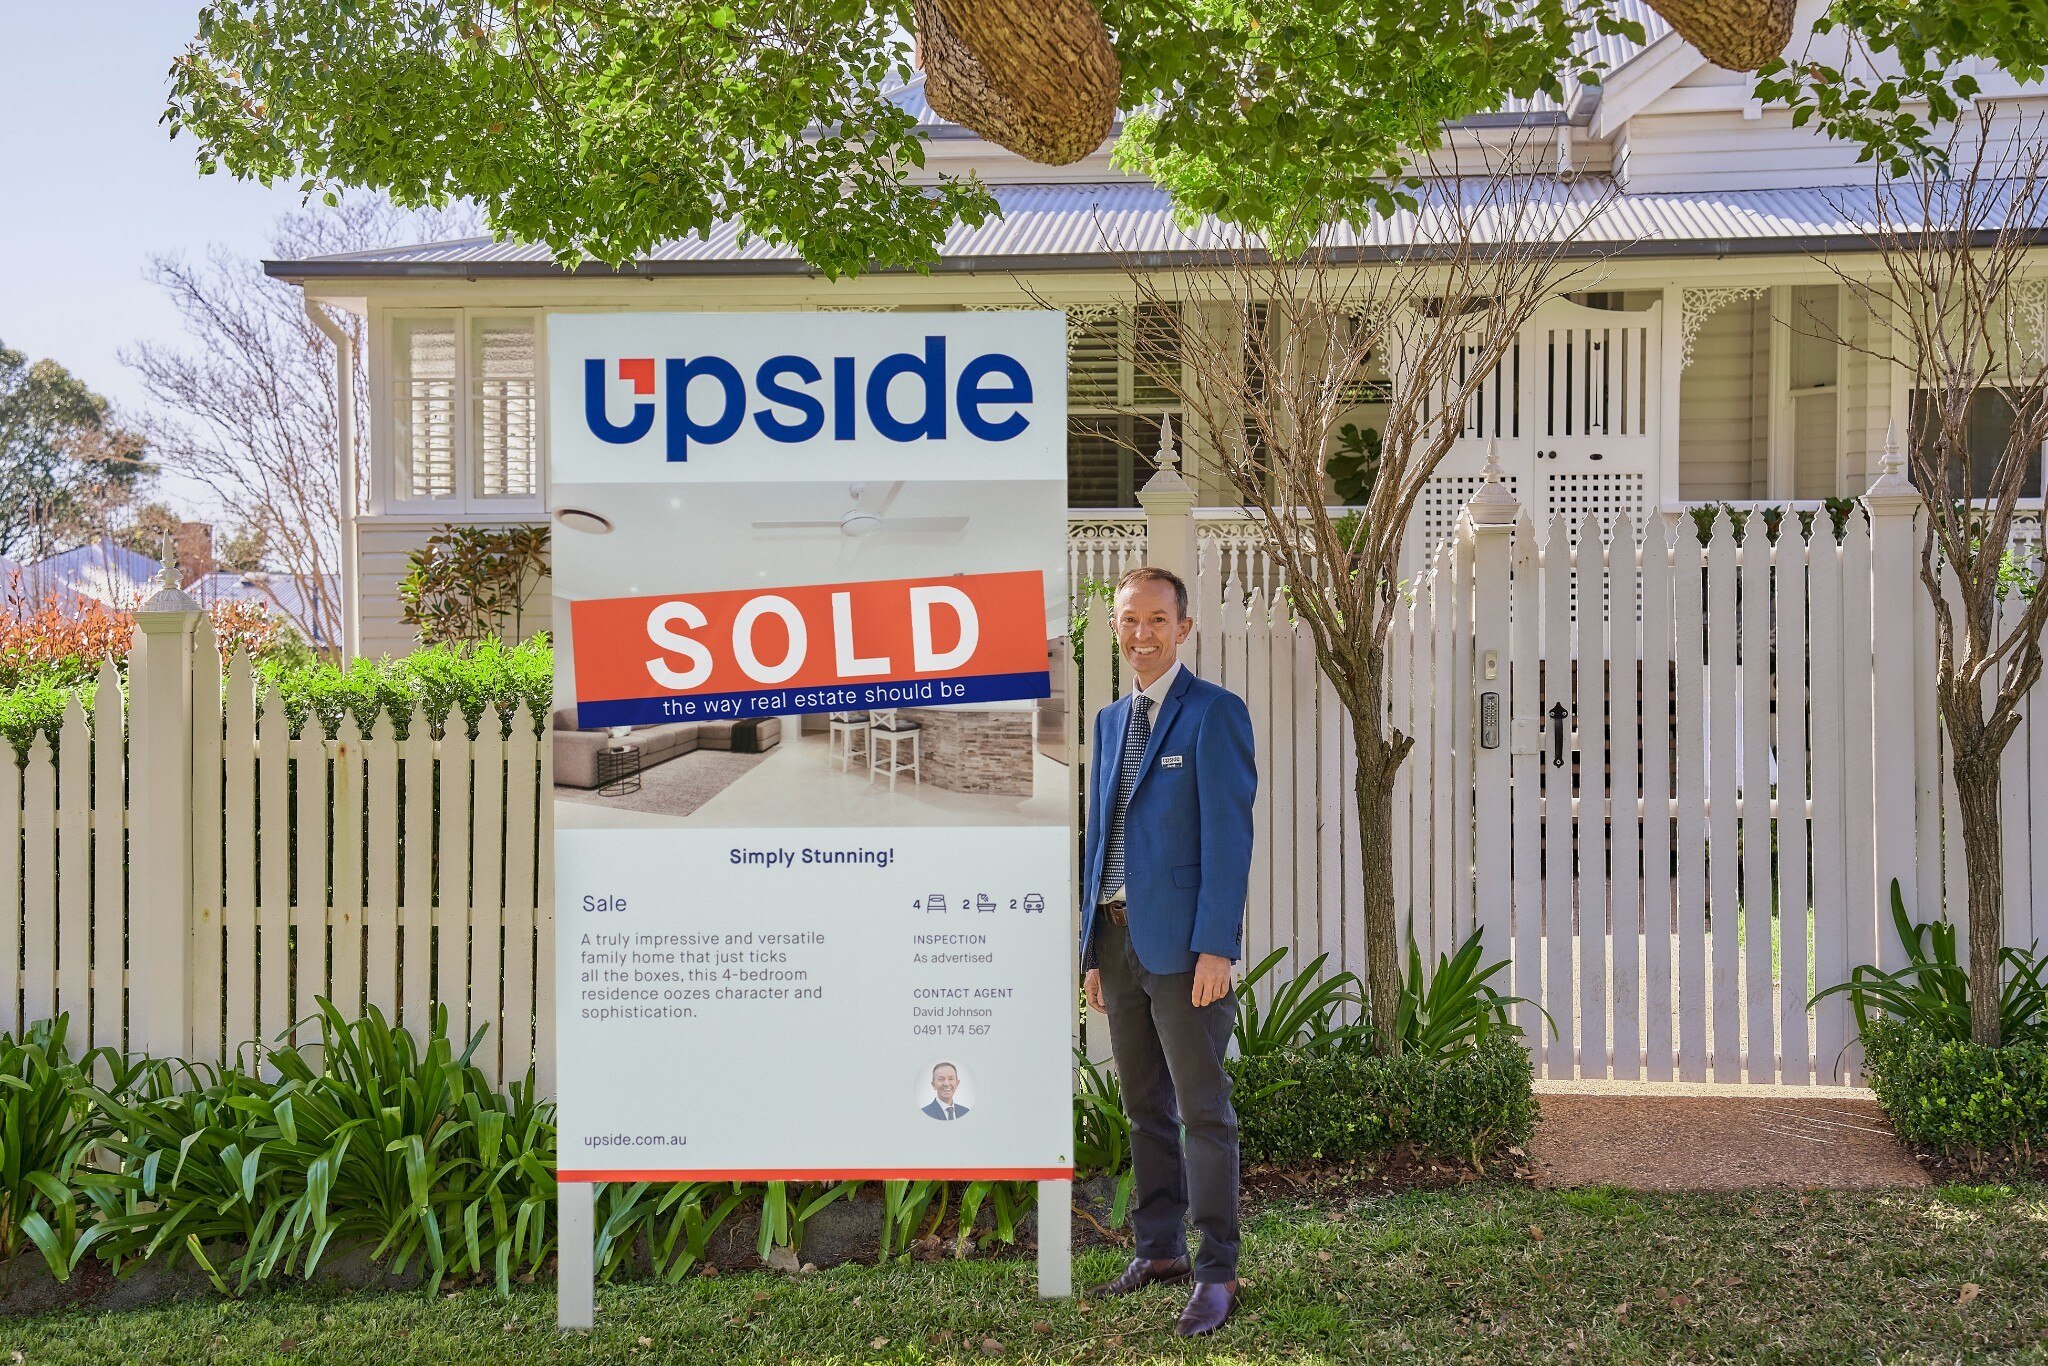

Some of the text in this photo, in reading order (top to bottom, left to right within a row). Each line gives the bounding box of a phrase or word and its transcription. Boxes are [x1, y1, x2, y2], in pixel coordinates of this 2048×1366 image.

[585, 336, 1033, 462] upside
[645, 585, 980, 691] SOLD
[662, 682, 965, 716] the way real estate should be
[731, 848, 894, 868] Simply Stunning!
[582, 895, 627, 912] Sale
[912, 899, 922, 910] 4
[962, 898, 971, 910] 2
[1009, 898, 1018, 910] 2
[580, 931, 825, 948] A truly impressive and versatile
[913, 934, 986, 945] INSPECTION
[580, 949, 787, 967] family home that just ticks
[913, 952, 993, 964] As advertised
[581, 967, 808, 982] all the boxes, this 4-bedroom
[581, 985, 822, 1000] residence oozes character and
[913, 988, 1014, 999] CONTACT AGENT
[581, 1005, 697, 1021] sophistication.
[913, 1006, 993, 1017] David Johnson
[913, 1024, 991, 1036] 0491 174 567
[584, 1134, 687, 1149] upside.com.au
